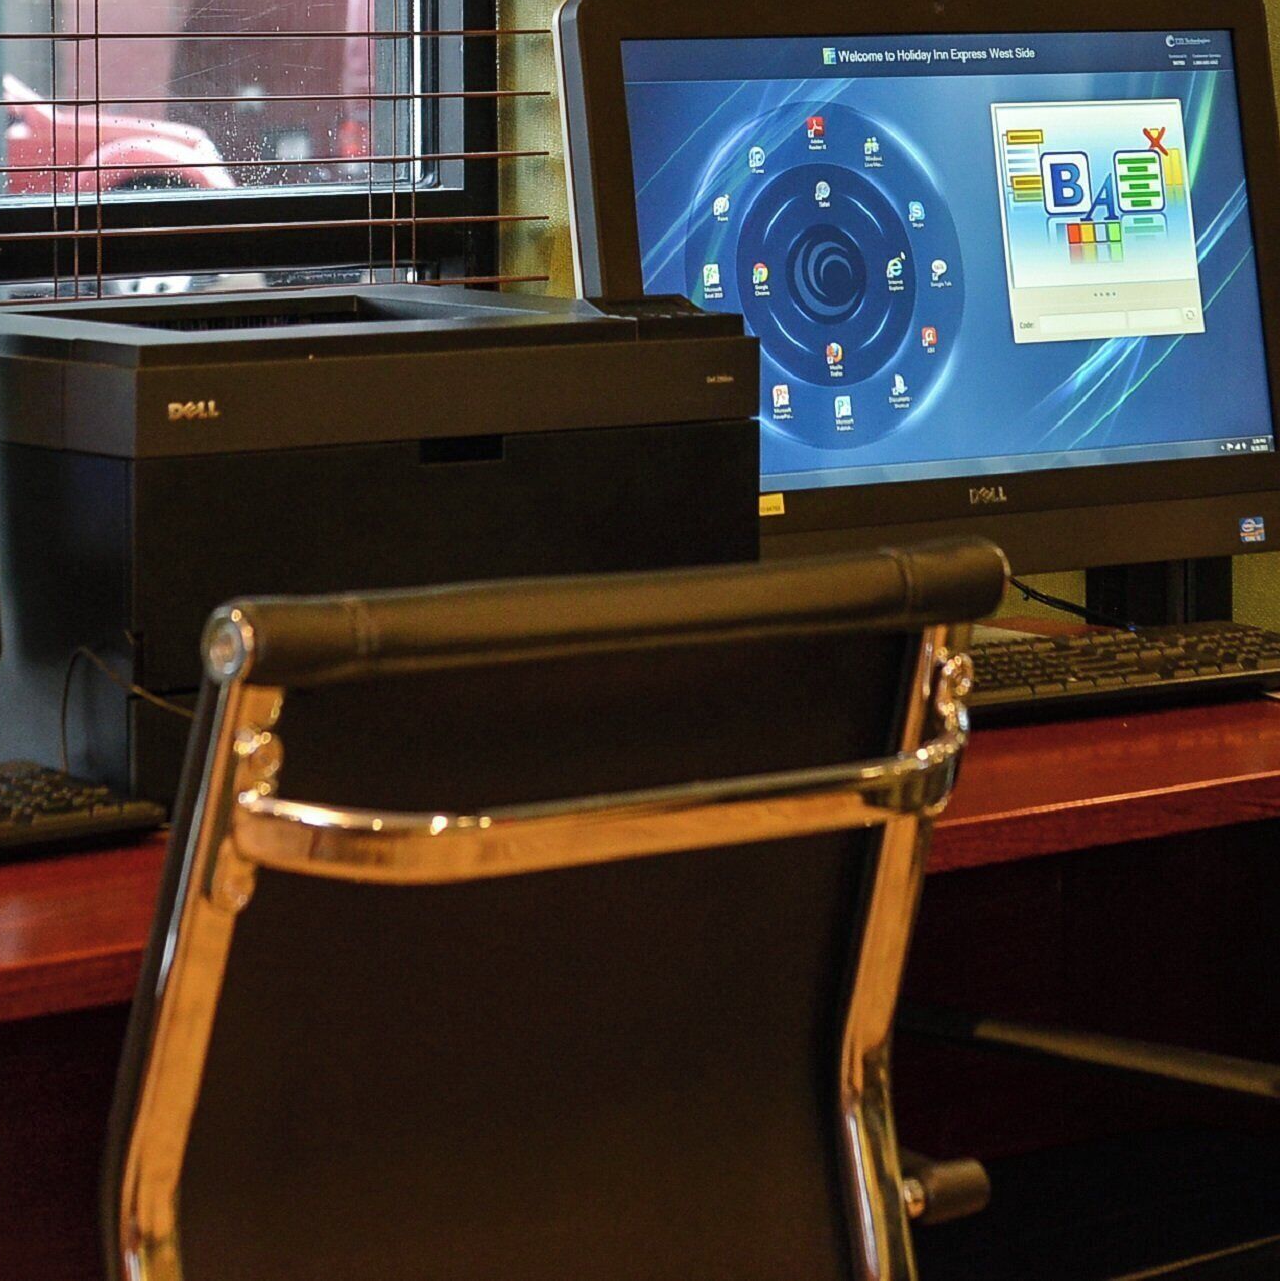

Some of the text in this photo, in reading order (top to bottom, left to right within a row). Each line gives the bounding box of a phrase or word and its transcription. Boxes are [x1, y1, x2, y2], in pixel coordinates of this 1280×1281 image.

[838, 47, 1035, 64] Welcome to Holiday Inn Express West Side
[1050, 162, 1119, 221] B A
[167, 399, 221, 420] DELL
[969, 486, 1008, 504] DELL
